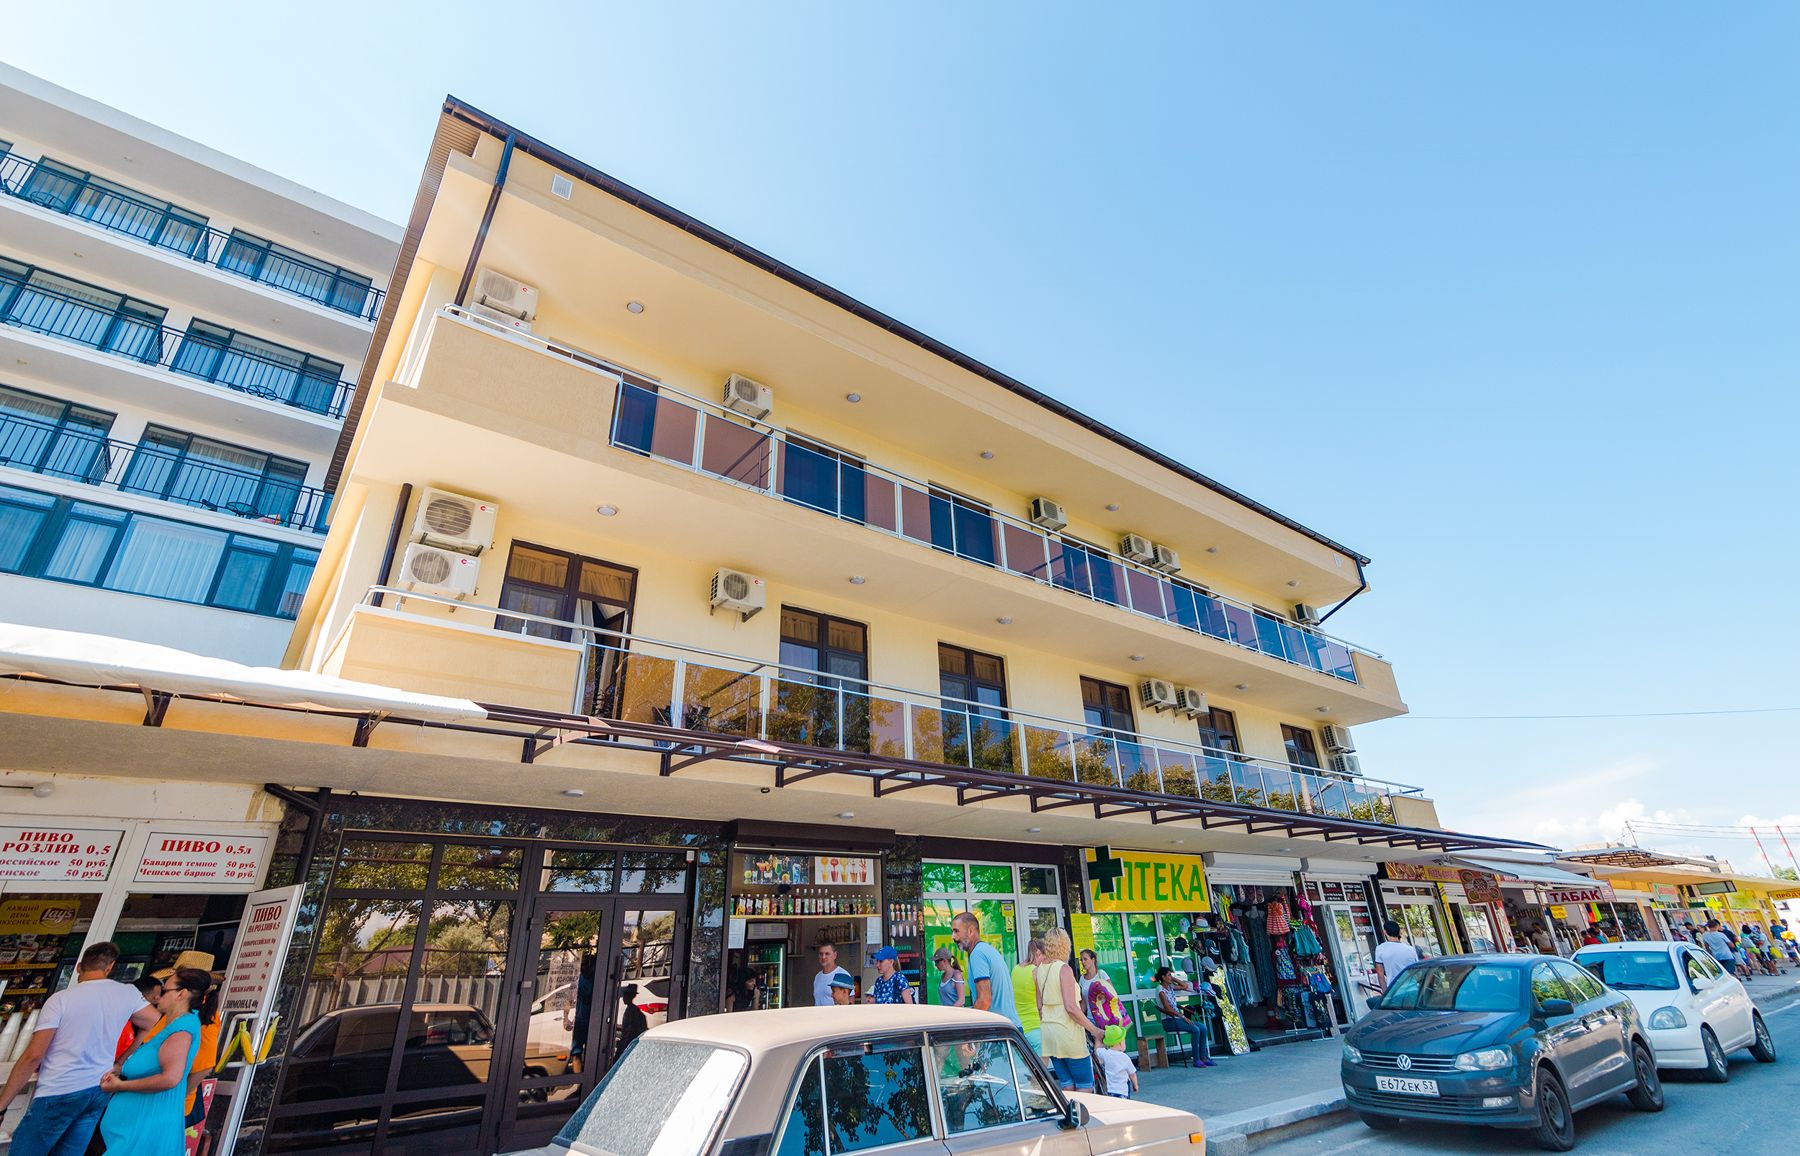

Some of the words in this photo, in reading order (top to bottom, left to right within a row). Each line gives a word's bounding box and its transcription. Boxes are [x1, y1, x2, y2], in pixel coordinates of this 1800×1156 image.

[19, 831, 74, 842] ПИВО
[2, 842, 80, 855] РОЗЛИВ
[86, 845, 112, 856] 0,5
[160, 839, 221, 854] ПИВО
[225, 845, 252, 855] 0,5л
[68, 858, 83, 867] 50
[85, 858, 109, 869] руб.
[142, 858, 183, 867] Бавария
[185, 860, 218, 868] темное
[225, 860, 237, 868] 50
[238, 861, 257, 869] руб.
[64, 868, 79, 877] 50
[81, 868, 105, 879] руб.
[140, 868, 182, 877] Чешское
[223, 869, 236, 877] 50
[237, 870, 256, 879] руб.
[1550, 889, 1601, 902] ТАБАК
[252, 906, 282, 923] ПИВО
[1422, 1080, 1434, 1090] 53
